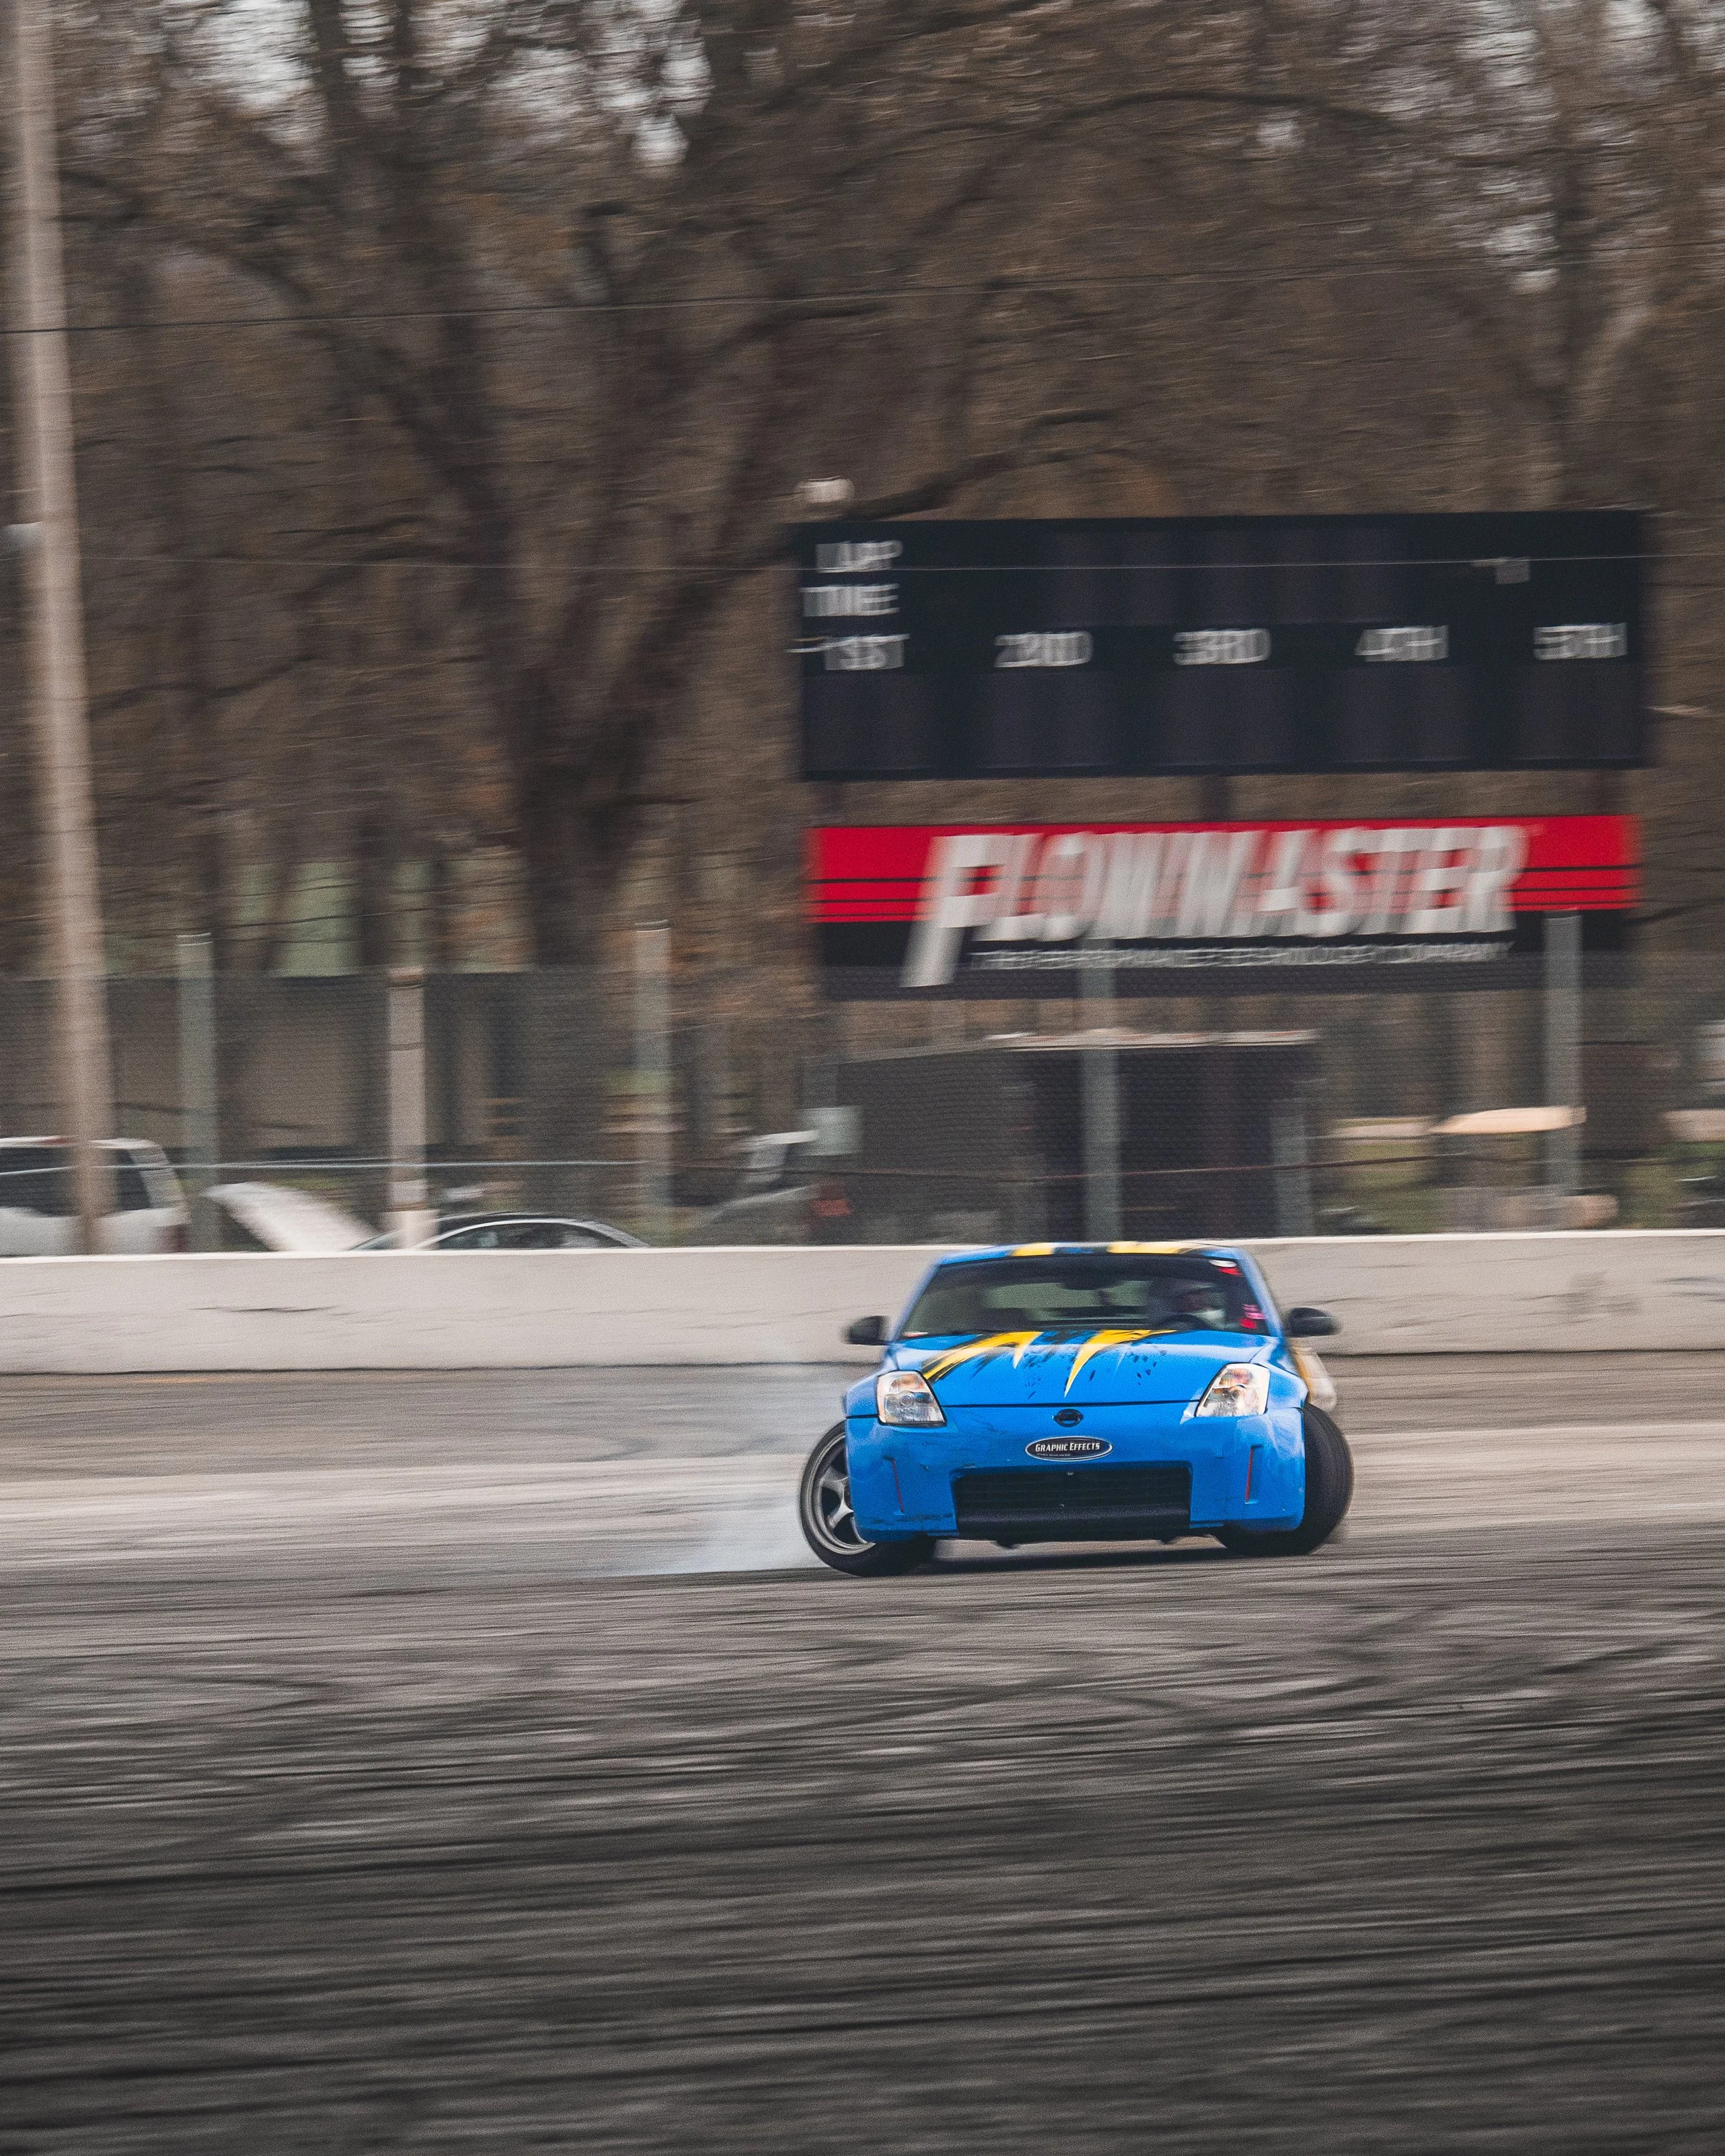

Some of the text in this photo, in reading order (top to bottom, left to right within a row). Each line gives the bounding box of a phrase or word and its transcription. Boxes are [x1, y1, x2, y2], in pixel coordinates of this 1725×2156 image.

[900, 825, 1529, 988] FLOWMASTER
[1035, 1442, 1101, 1452] GRAPHIC EFFECTS
